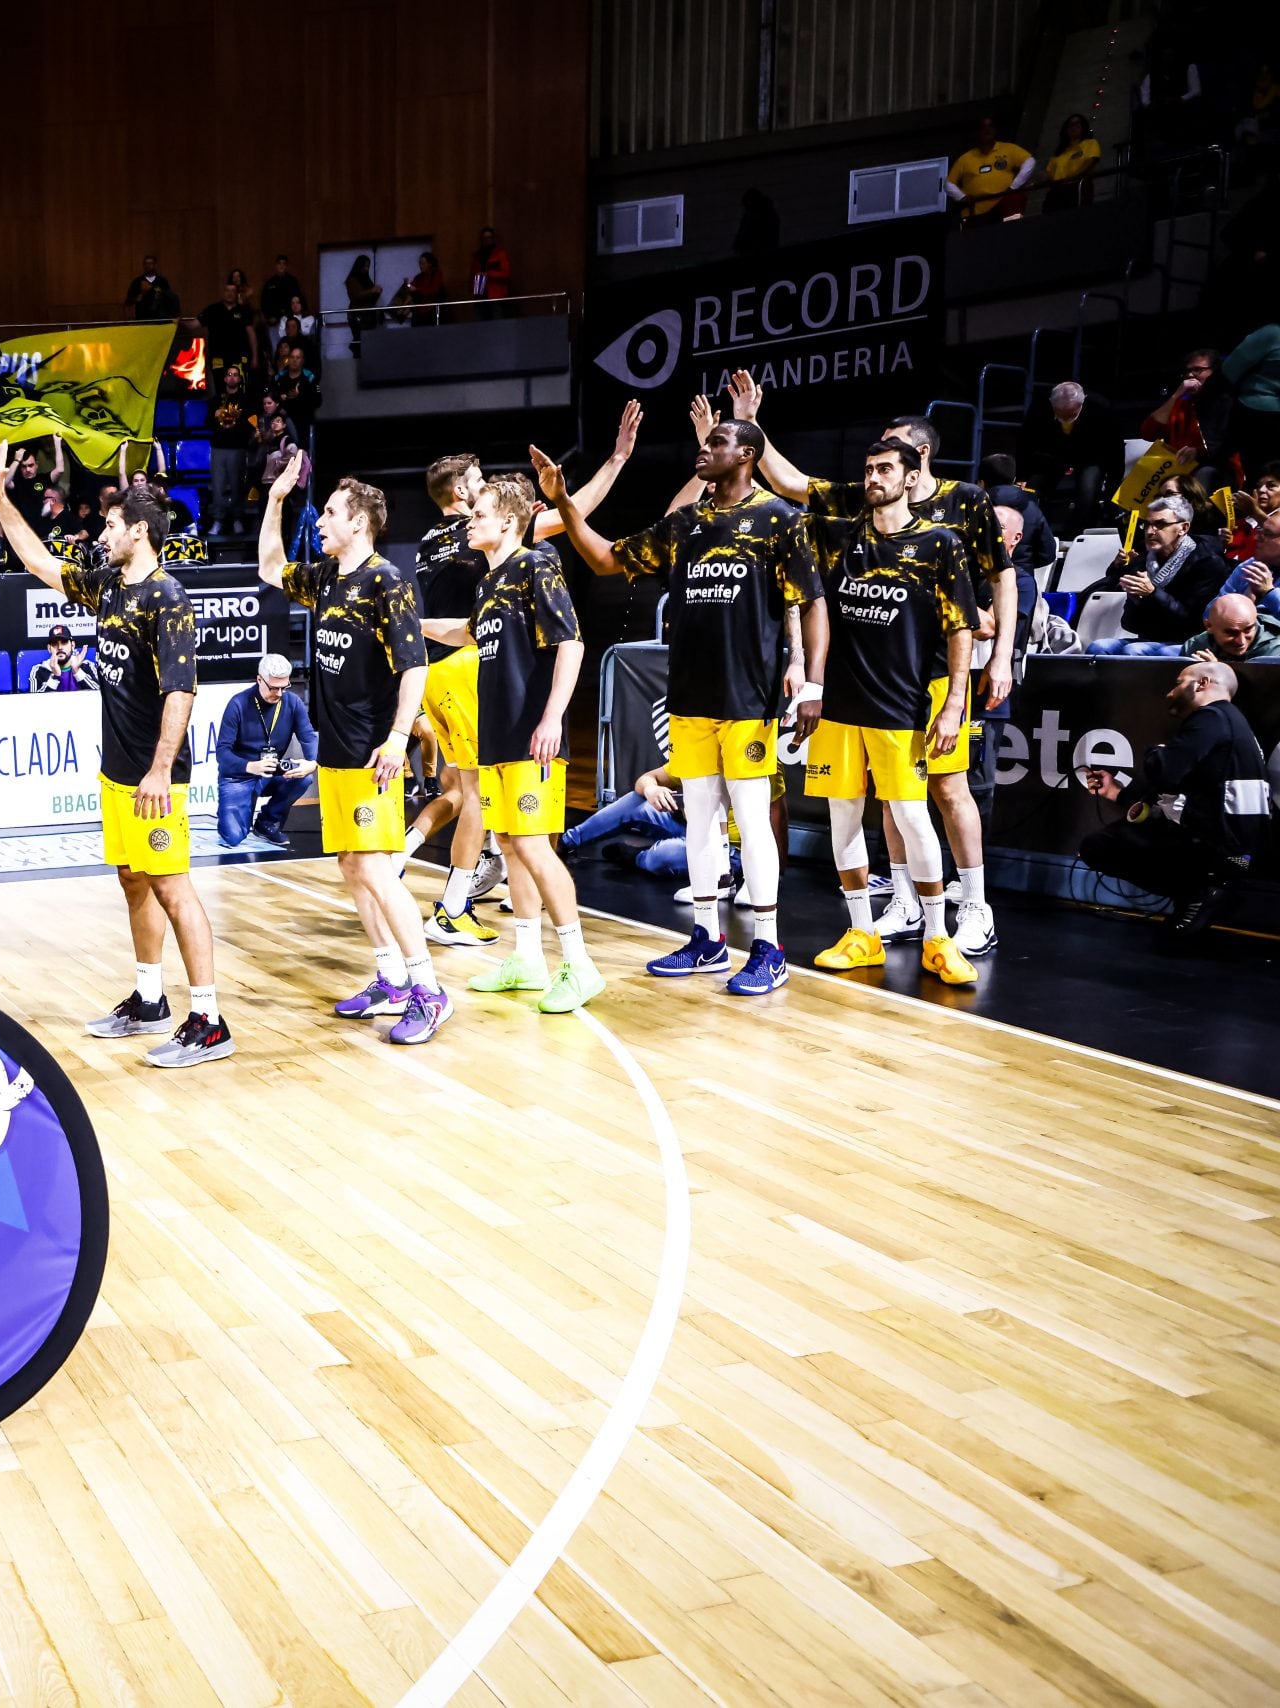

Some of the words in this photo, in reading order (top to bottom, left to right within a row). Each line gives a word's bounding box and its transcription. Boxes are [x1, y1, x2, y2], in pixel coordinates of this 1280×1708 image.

[692, 255, 931, 349] RECORD
[702, 341, 914, 399] LAANDERIA
[1133, 460, 1173, 505] Lenovo
[687, 562, 748, 579] Lenovo
[838, 576, 908, 602] Lenovo
[190, 597, 260, 619] ERRO
[317, 628, 352, 649] enovo
